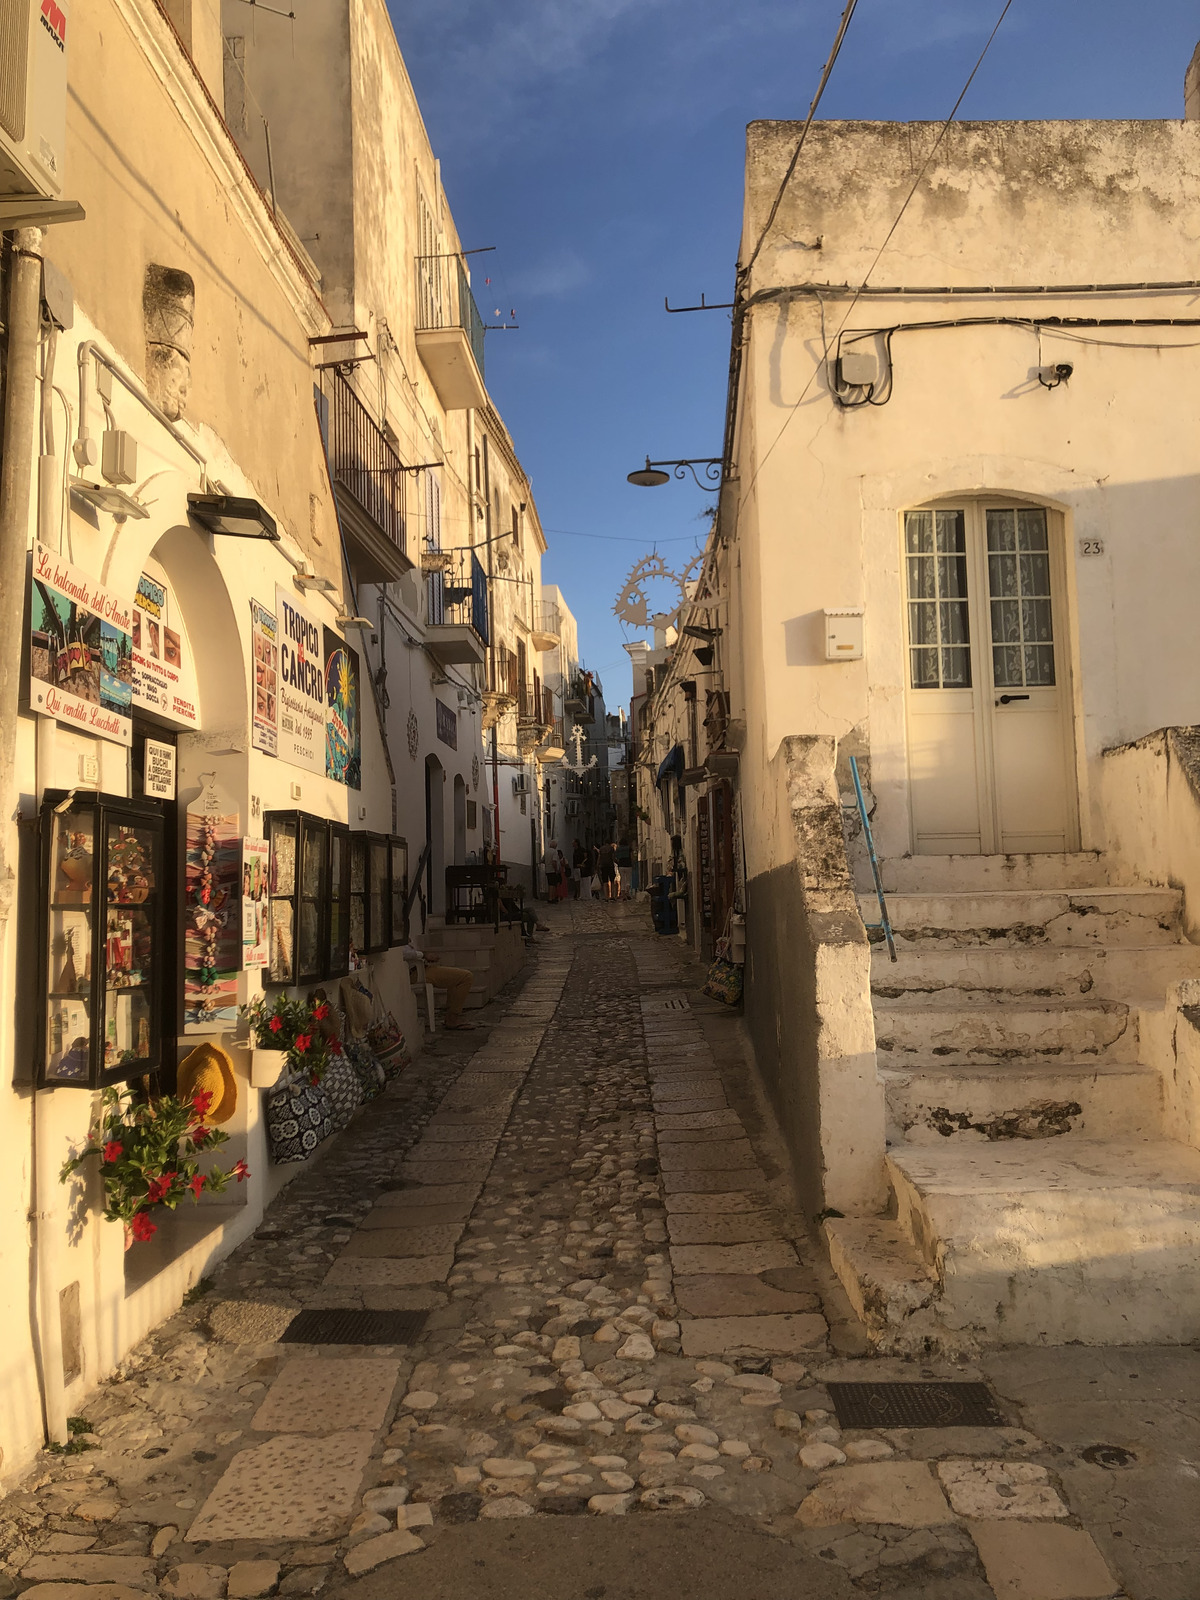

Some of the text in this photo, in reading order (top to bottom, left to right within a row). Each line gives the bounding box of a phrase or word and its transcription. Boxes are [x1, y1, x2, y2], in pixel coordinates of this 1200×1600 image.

[1084, 542, 1100, 554] 23
[36, 551, 130, 629] La balconata dell'Amore
[138, 576, 165, 608] OPICO
[282, 600, 319, 658] TROPICO
[132, 651, 146, 667] ERCING
[152, 662, 163, 675] TUTTO
[167, 670, 179, 683] CORPO
[281, 643, 323, 704] CANCRO
[46, 688, 121, 735] Qui vendita Lucchetti
[173, 695, 195, 712] VENDITA
[172, 704, 196, 721] PIERCING
[303, 725, 313, 740] 1995
[294, 743, 315, 760] PESCHICI
[152, 756, 168, 769] BUCHI
[148, 772, 172, 786] CARTILAGINE
[152, 765, 172, 778] ORECCHIE
